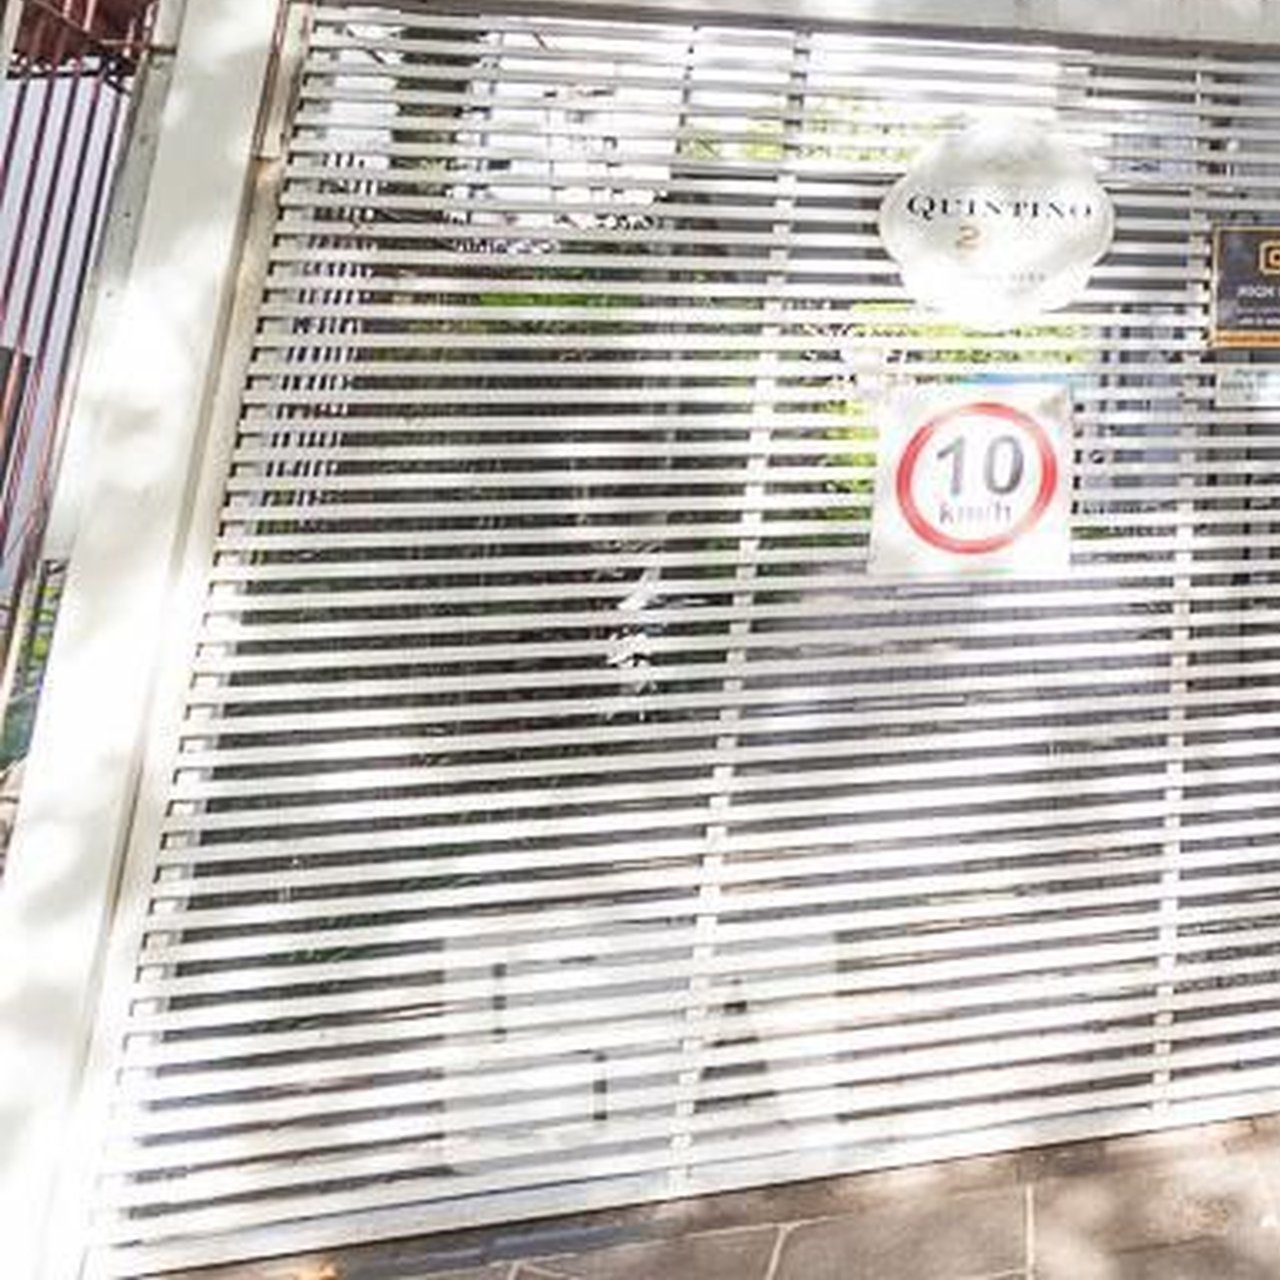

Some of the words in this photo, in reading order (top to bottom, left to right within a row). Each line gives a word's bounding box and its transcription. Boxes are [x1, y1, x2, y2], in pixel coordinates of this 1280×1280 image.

[906, 194, 1092, 221] QUINTINO
[935, 433, 1026, 497] 10
[938, 500, 1013, 526] km/h
